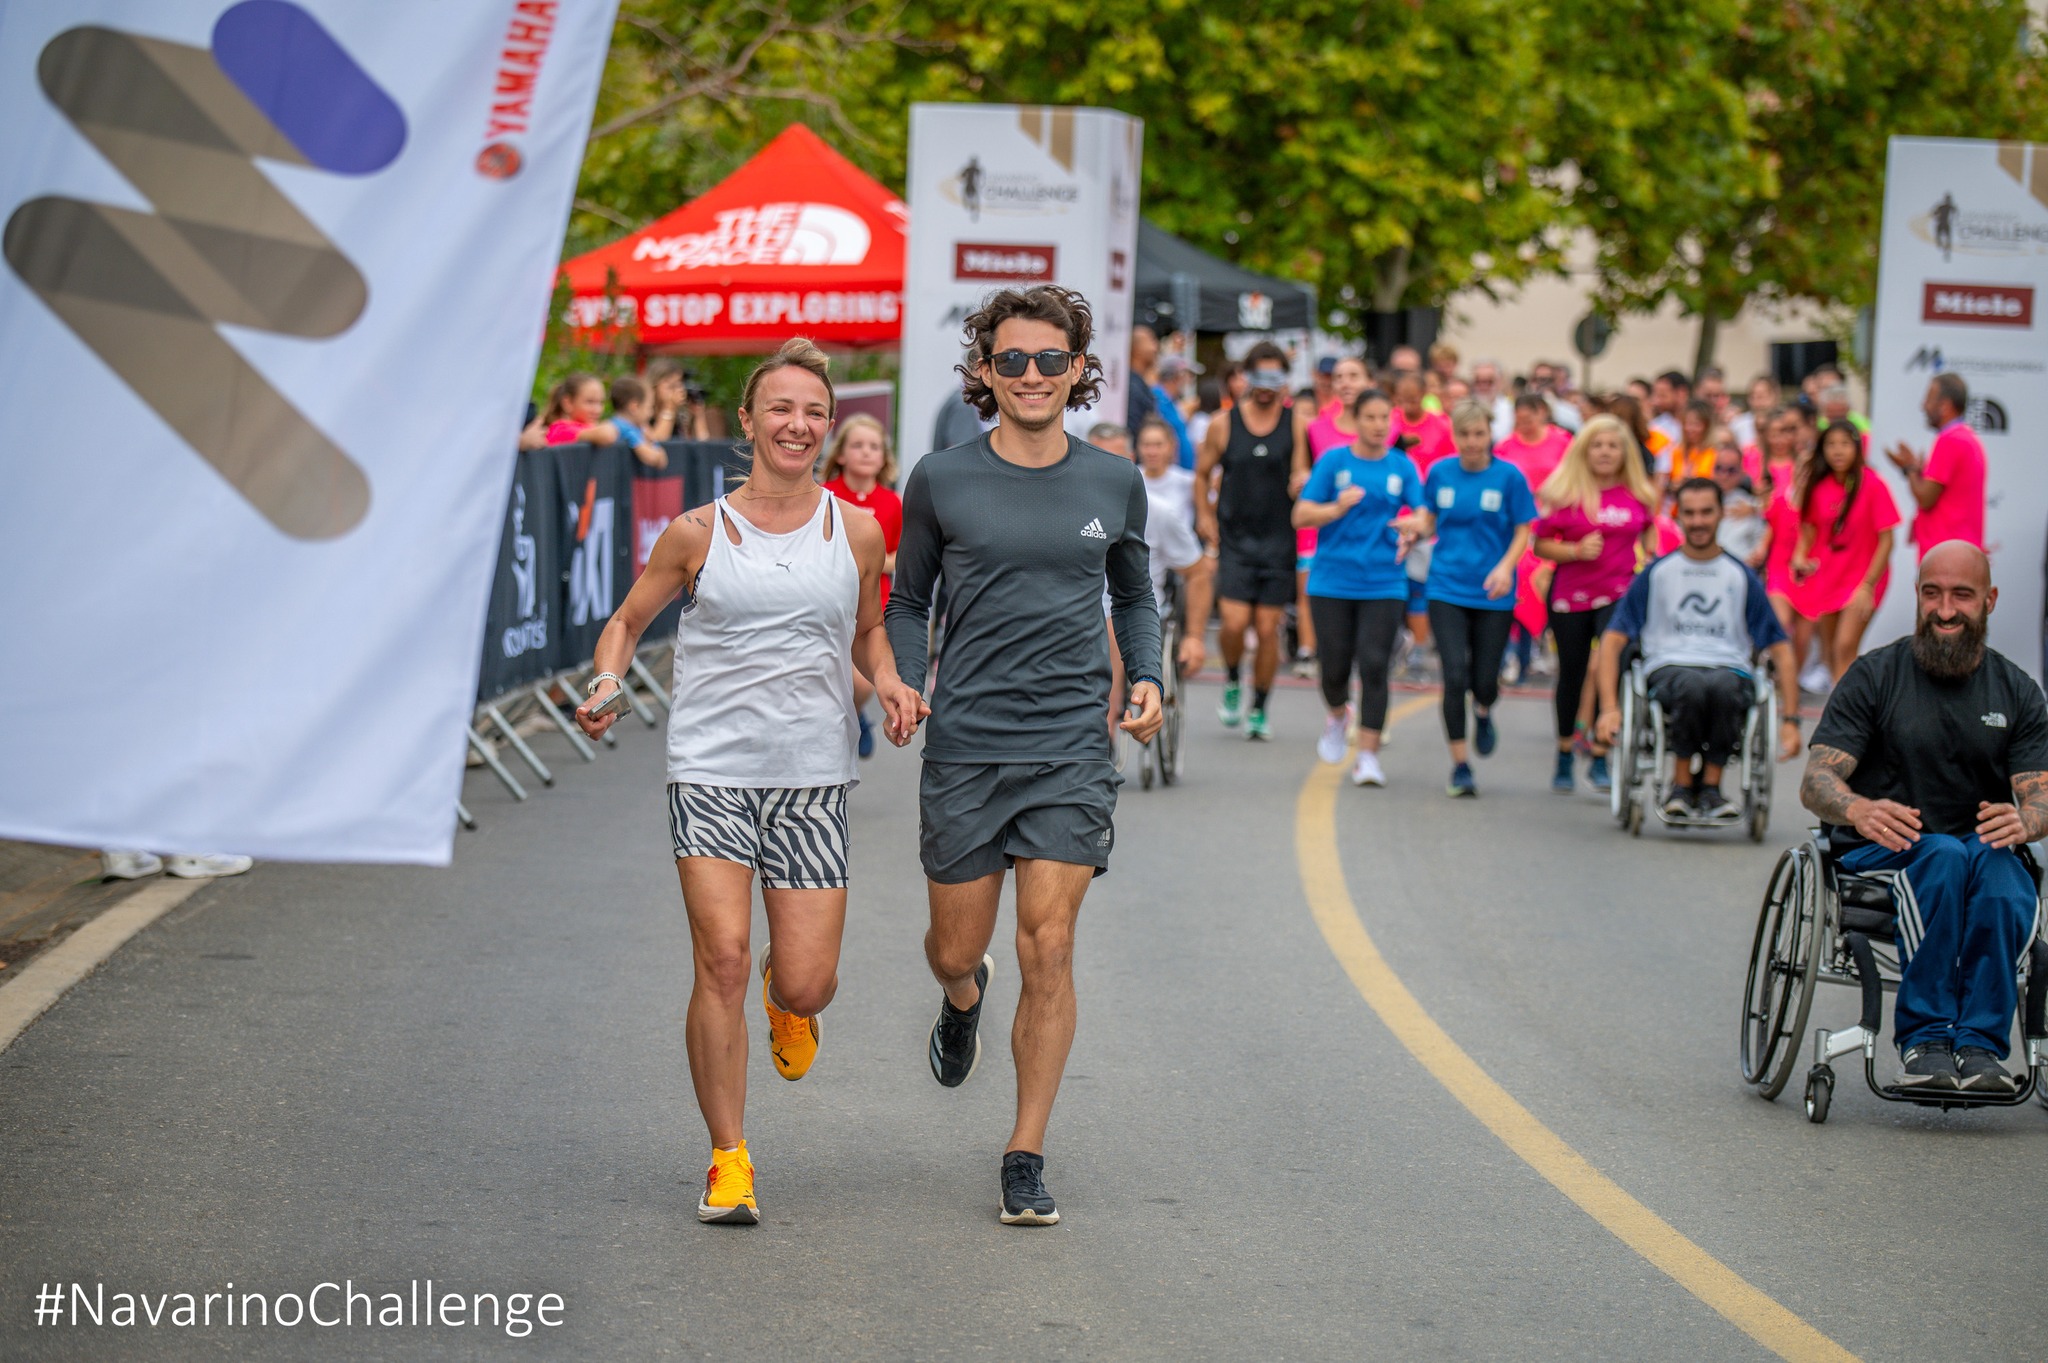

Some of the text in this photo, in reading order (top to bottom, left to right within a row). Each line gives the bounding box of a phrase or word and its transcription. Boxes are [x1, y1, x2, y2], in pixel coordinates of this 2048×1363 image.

[485, 0, 559, 139] YAMAHA
[713, 202, 800, 233] THE
[632, 229, 789, 261] NORTH
[652, 249, 779, 272] FACE
[961, 249, 1048, 275] Miele
[645, 292, 723, 327] STOP
[729, 290, 898, 325] EXPLORING
[1932, 290, 2024, 317] Miele
[1080, 529, 1107, 539] adidas
